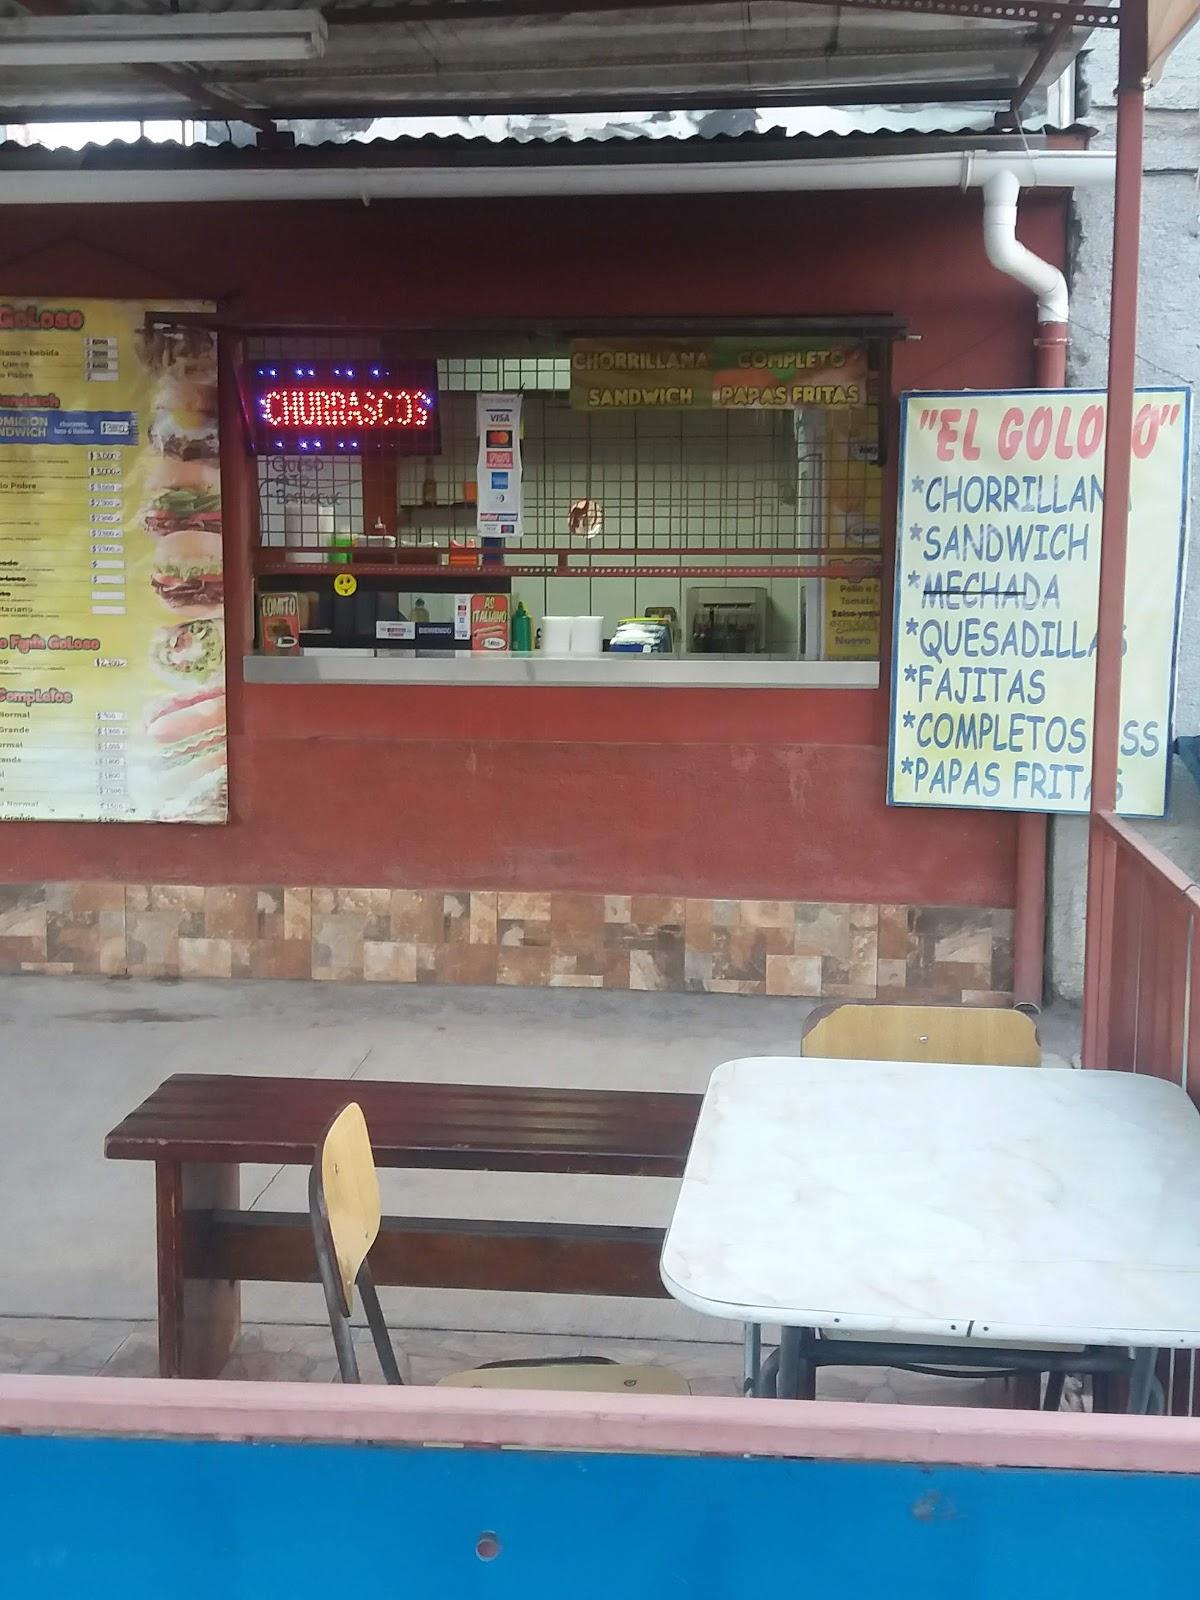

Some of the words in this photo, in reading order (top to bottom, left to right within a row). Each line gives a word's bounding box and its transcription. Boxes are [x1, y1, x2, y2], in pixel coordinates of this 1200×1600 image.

[571, 352, 709, 371] CHORRILLANA
[737, 350, 847, 368] COMPLETO
[264, 391, 428, 426] CHURRASCOS
[588, 387, 693, 405] SANDWICH
[720, 386, 787, 404] PAPAS
[792, 386, 859, 404] FRITAS
[490, 414, 511, 423] VISA
[997, 403, 1181, 461] GOLOO"
[926, 474, 1132, 514] CHORRILLAN
[923, 523, 1089, 562] SANDWICH
[484, 597, 494, 609] AS
[921, 570, 1060, 610] MECHADA
[262, 597, 297, 617] LOMITO
[472, 610, 507, 624] ITALIANO
[918, 664, 1046, 705] FAJITAS
[916, 712, 1086, 754] COMPLETOS
[914, 756, 1001, 797] PAPAS
